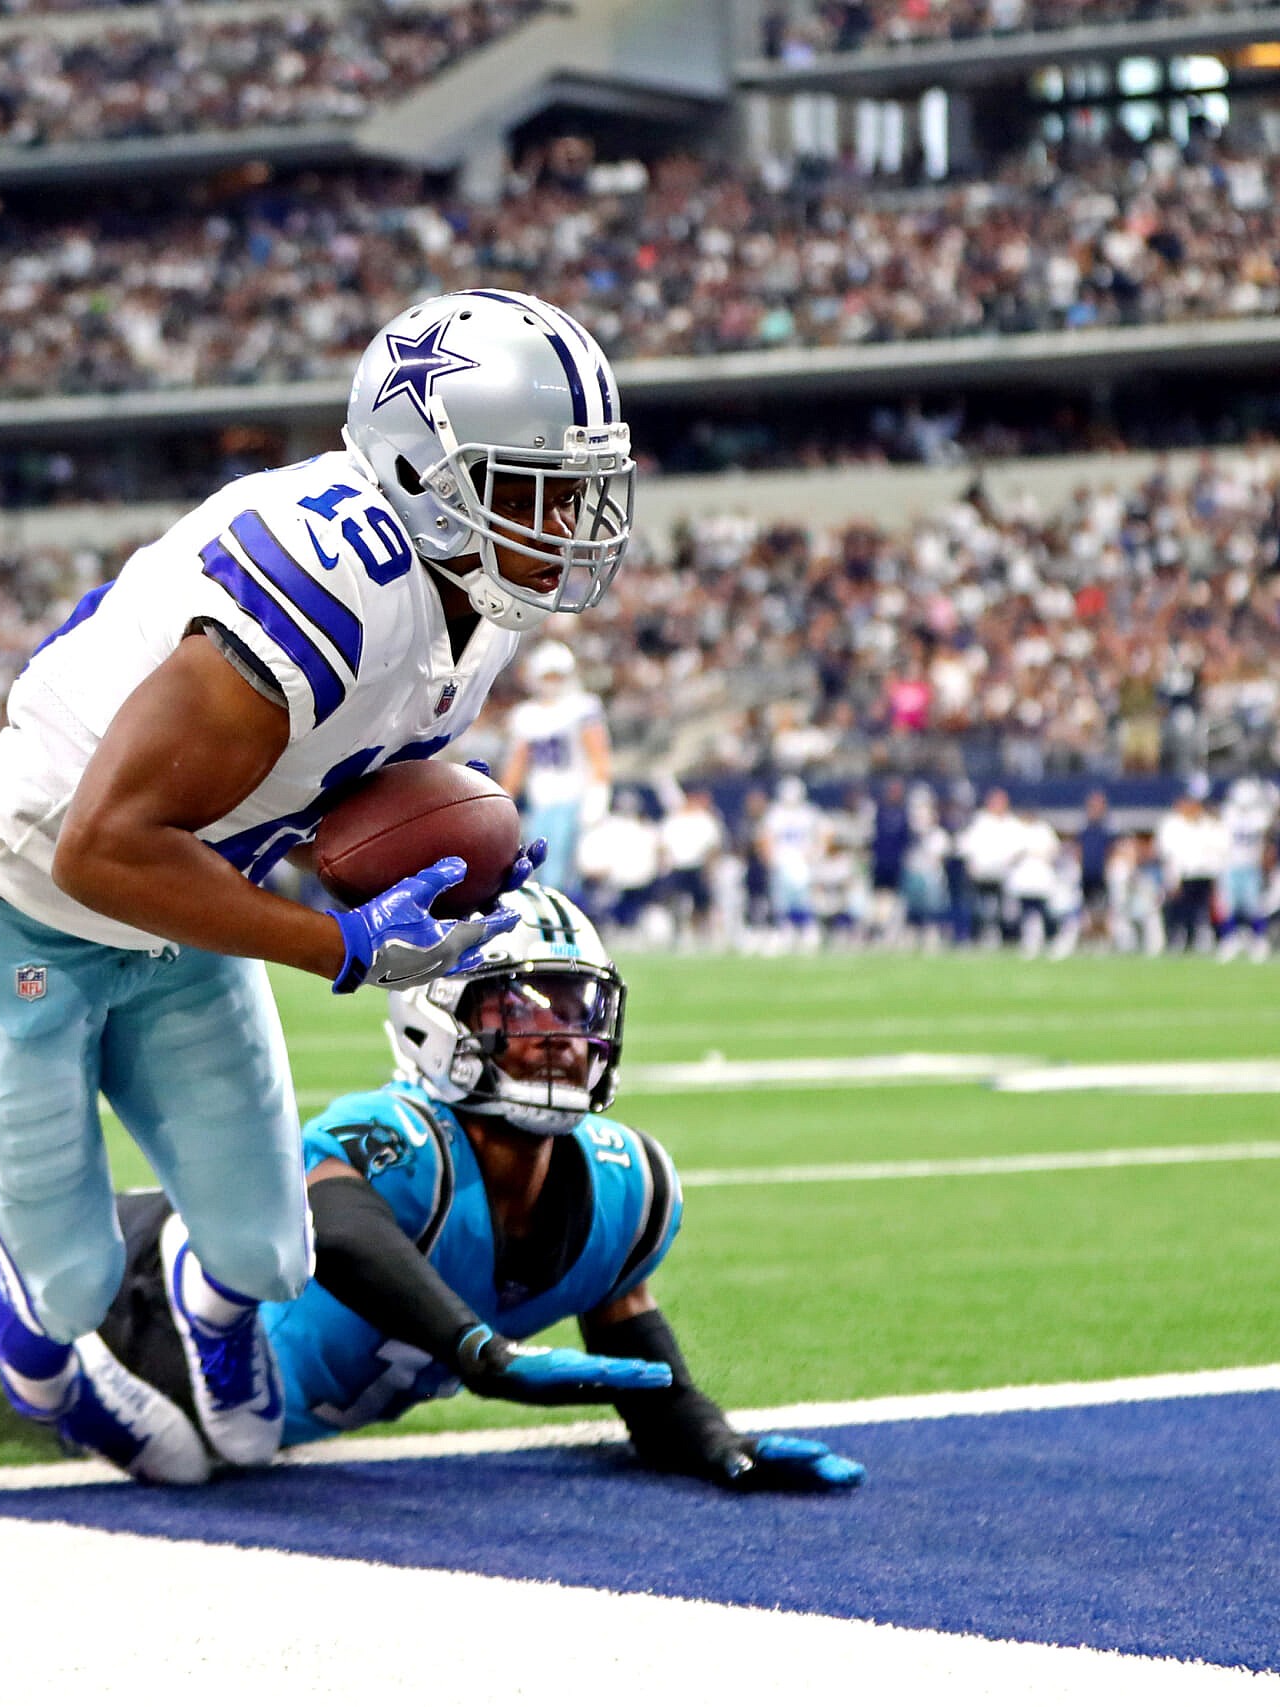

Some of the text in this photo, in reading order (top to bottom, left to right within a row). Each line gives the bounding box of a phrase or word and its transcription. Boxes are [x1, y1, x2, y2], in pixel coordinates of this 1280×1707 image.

[296, 484, 412, 586] 19
[20, 982, 42, 995] NFL
[585, 1124, 631, 1168] 15
